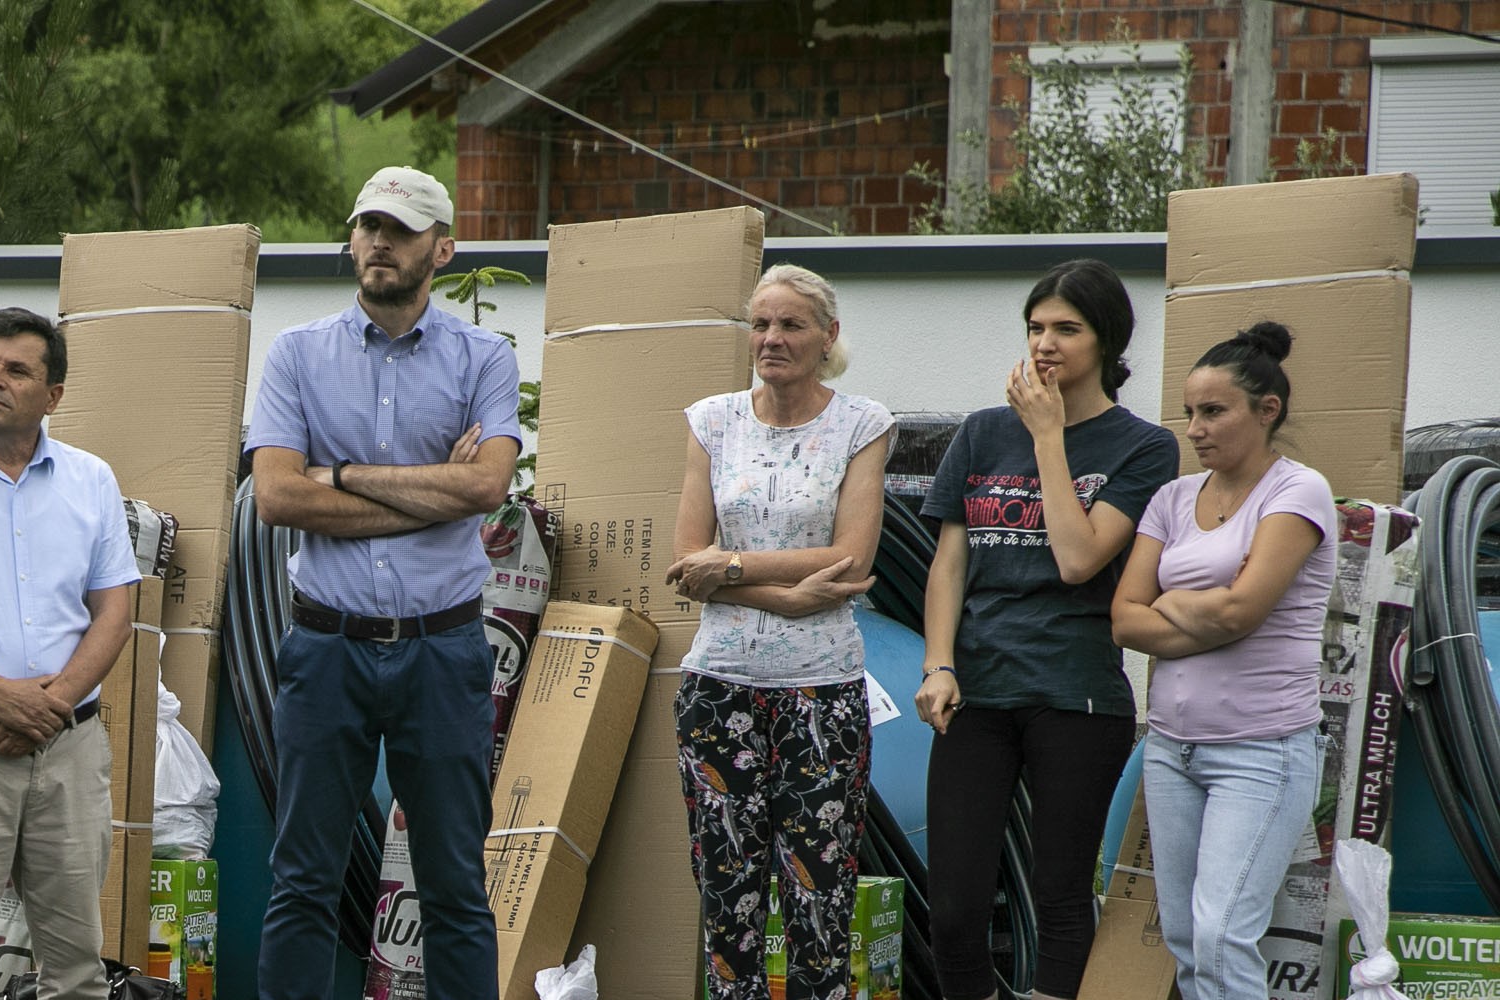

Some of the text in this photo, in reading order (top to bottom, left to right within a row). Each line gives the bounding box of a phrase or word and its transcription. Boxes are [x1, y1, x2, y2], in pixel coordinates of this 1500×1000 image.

[375, 186, 412, 198] Delphy
[588, 522, 600, 572] COLOR:
[606, 520, 617, 553] SIZE:
[623, 520, 635, 559] DESC:
[642, 518, 653, 549] ITEM
[170, 565, 187, 604] ATF
[573, 646, 600, 698] DAFU
[1359, 692, 1392, 833] ULTRA MULCH
[527, 833, 541, 862] DEEP
[1137, 821, 1152, 851] WEL
[517, 862, 533, 895] WELL
[187, 889, 212, 903] WOLTER
[507, 896, 522, 929] PUMP
[871, 910, 897, 929] WOLTER
